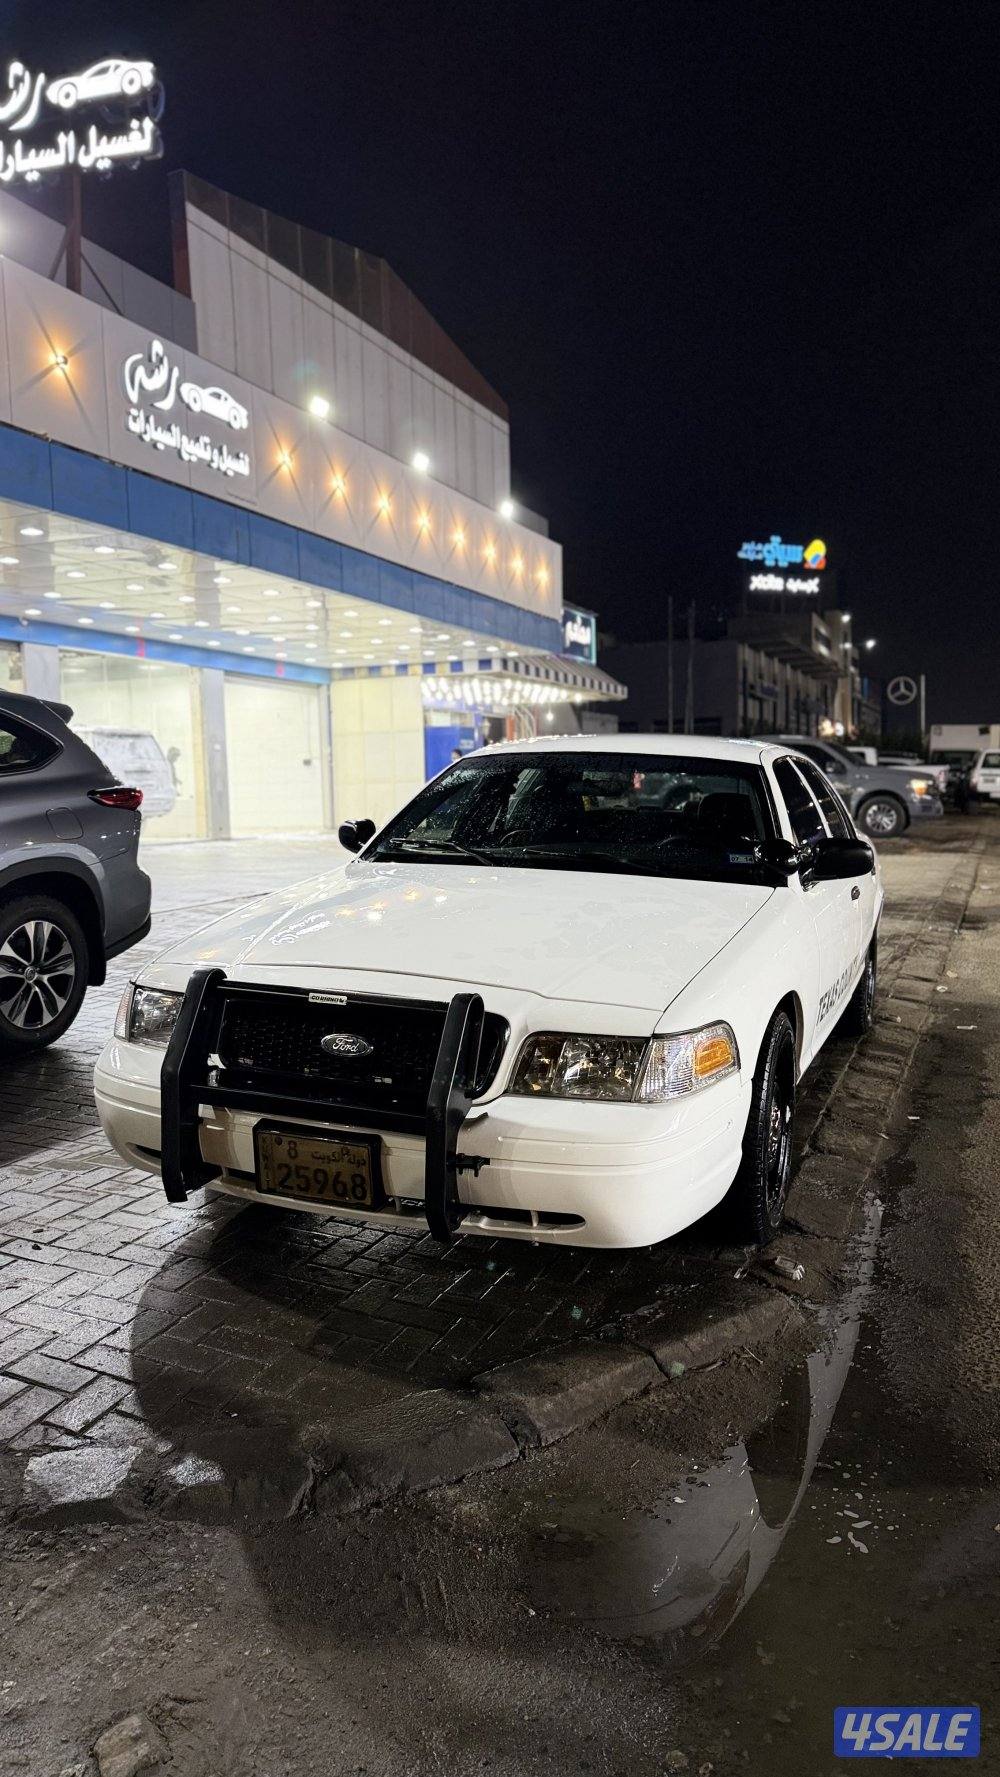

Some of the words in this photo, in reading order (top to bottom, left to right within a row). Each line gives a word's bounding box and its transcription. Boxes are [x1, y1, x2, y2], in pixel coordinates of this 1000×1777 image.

[0, 130, 75, 182] السيارا
[78, 116, 154, 170] لغسيل
[127, 407, 181, 451] السيارات
[332, 1037, 360, 1052] Ford
[287, 1140, 298, 1159] 8
[277, 1163, 368, 1201] 25968
